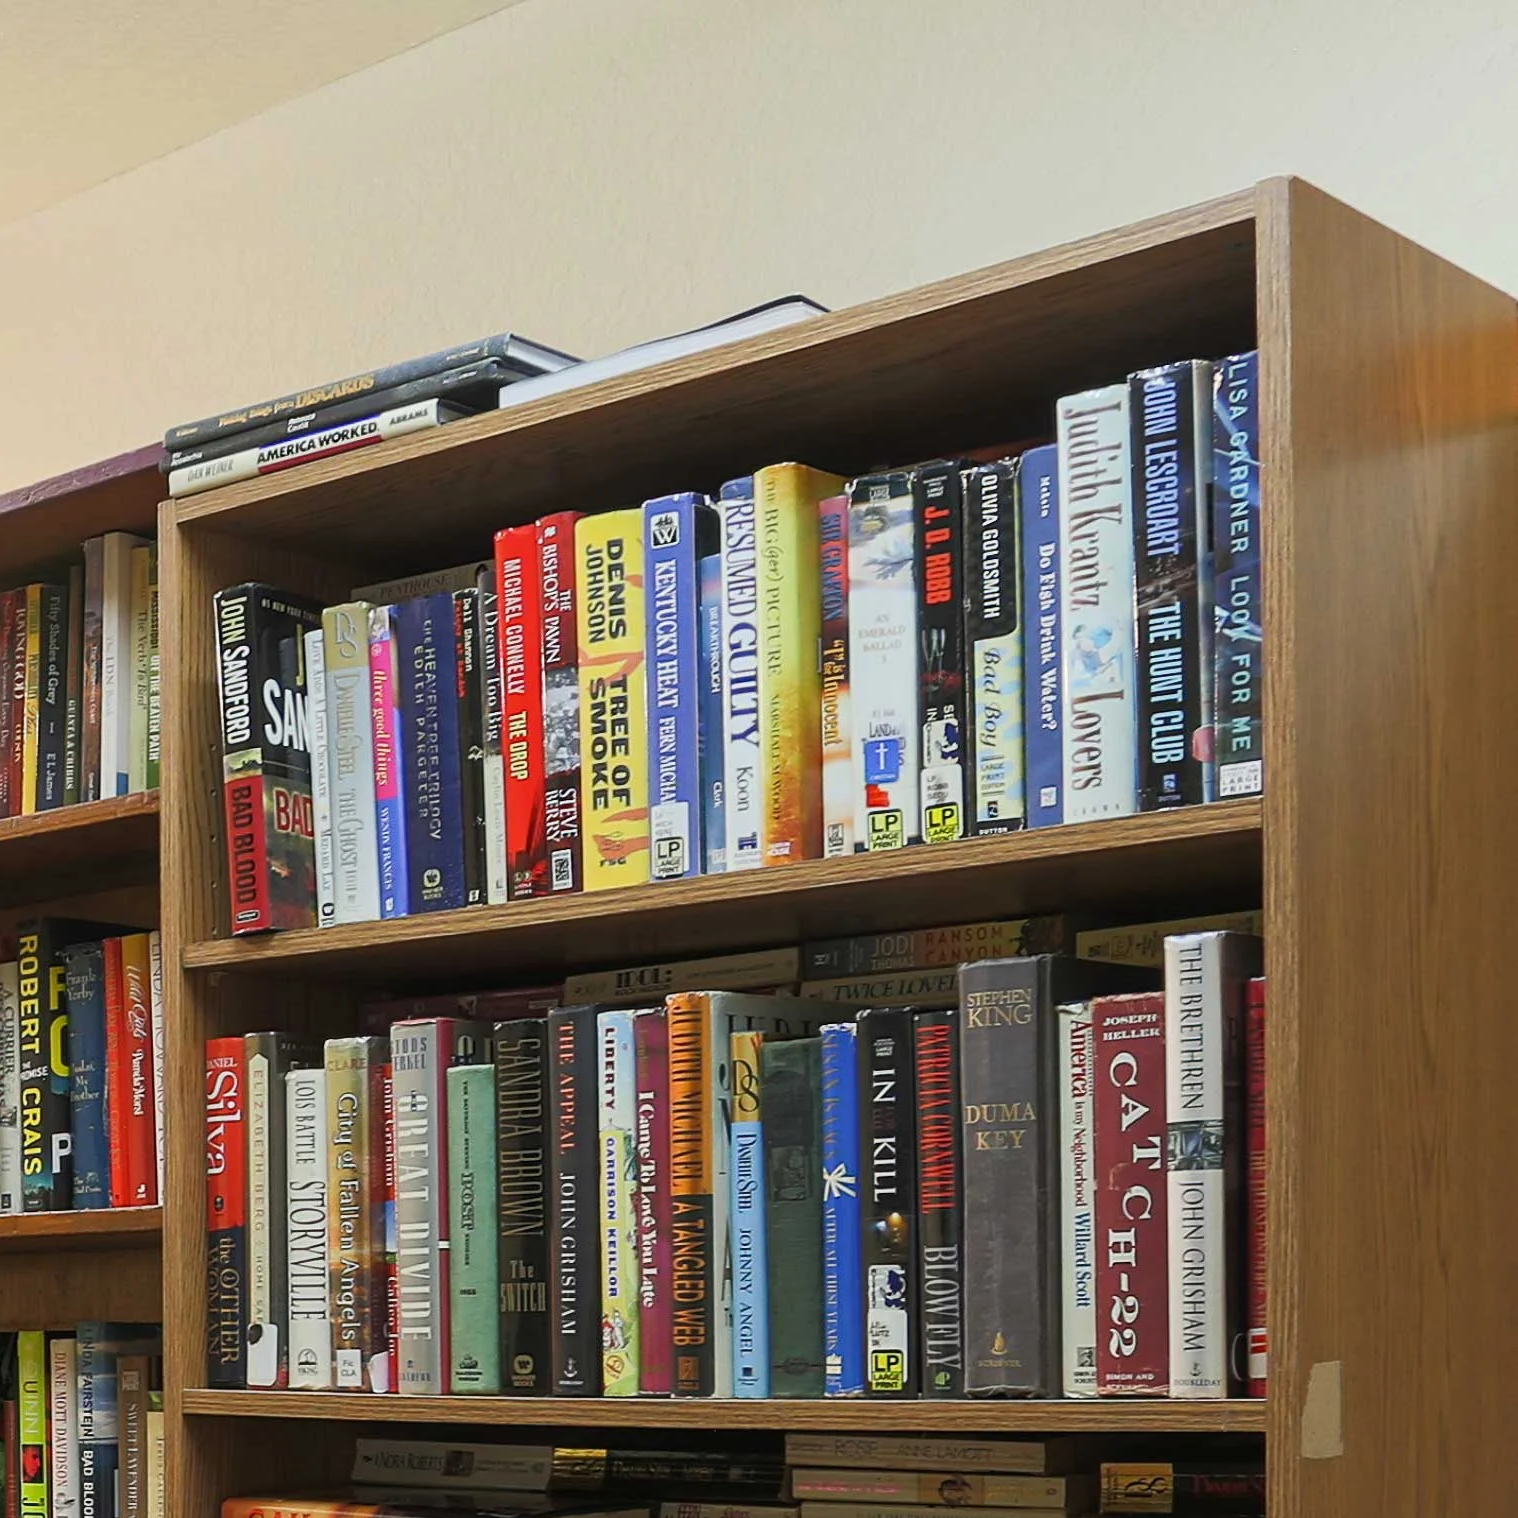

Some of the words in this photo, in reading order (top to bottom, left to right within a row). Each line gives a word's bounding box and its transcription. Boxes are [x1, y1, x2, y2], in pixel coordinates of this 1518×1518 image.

[1143, 380, 1177, 434] JOHN
[1228, 356, 1247, 421] LISA
[389, 408, 428, 426] ABRAMS
[257, 439, 315, 464] AMERICA
[1066, 400, 1123, 491] Judith
[924, 506, 949, 525] J.
[979, 474, 997, 523] OLIVIA
[1144, 440, 1179, 555] LESCROART
[1229, 429, 1250, 553] GARDNER
[924, 529, 950, 548] D.
[1038, 543, 1055, 564] Do
[1068, 502, 1123, 611] Krantz
[503, 558, 522, 625] MICHAEL
[542, 544, 560, 611] BISHOP'S
[560, 589, 572, 612] THE
[586, 544, 606, 644] JOHNSON
[606, 538, 627, 640] DENIS
[924, 552, 953, 605] ROBB
[980, 528, 999, 619] GOLDSMITH
[1038, 568, 1056, 605] Fish
[219, 596, 248, 640] JOHN
[654, 559, 676, 655] KENTUCKY
[1148, 601, 1181, 641] THE
[1230, 576, 1251, 636] LOOK
[505, 629, 526, 695] CONNELLY
[545, 616, 561, 664] PAWN
[1038, 609, 1056, 663] Drink
[224, 644, 250, 744] SANDFORD
[656, 658, 679, 709] HEAT
[728, 621, 760, 749] GUILTY
[982, 651, 1003, 695] Bad
[1039, 665, 1058, 730] Water?
[1148, 645, 1182, 702] HUNT
[1230, 655, 1251, 702] FOR
[508, 710, 527, 741] THE
[608, 673, 628, 756] TREE
[982, 704, 1003, 748] Boy
[1071, 688, 1124, 791] Lovers
[1150, 709, 1185, 764] CLUB
[1231, 712, 1251, 751] ME
[509, 743, 528, 780] DROP
[589, 678, 608, 811] SMOKE
[232, 785, 253, 829] BAD
[561, 788, 578, 837] STEVE
[611, 765, 631, 807] OF
[546, 789, 561, 843] BERRY
[232, 833, 257, 904] BLOOD
[1179, 943, 1203, 982] THE
[20, 935, 40, 1055] ROBERT
[966, 989, 1033, 1007] STEPHEN
[967, 1005, 1033, 1029] KING
[1103, 1013, 1157, 1027] JOSEPH
[559, 1021, 575, 1065] THE
[1103, 1028, 1160, 1040] HELLER
[1179, 987, 1203, 1110] BRETHREN
[499, 1038, 543, 1140] SANDRA
[604, 1026, 616, 1110] LIBERTY
[296, 1079, 315, 1114] LOIS
[333, 1093, 357, 1144] City
[559, 1075, 576, 1158] APPEAL
[965, 1103, 1036, 1125] DUMA
[22, 1086, 42, 1177] CRAIS
[296, 1115, 315, 1165] BATTLE
[976, 1130, 1025, 1150] KEY
[336, 1152, 357, 1169] of
[606, 1137, 616, 1221] GARRISON
[339, 1180, 360, 1251] Fallen
[500, 1149, 544, 1238] BROWN
[559, 1172, 576, 1224] JOHN
[673, 1201, 693, 1215] A
[1107, 1050, 1163, 1359] CATCH-22
[1178, 1181, 1204, 1241] JOHN
[289, 1180, 326, 1321] STORYVILLE
[607, 1225, 618, 1299] KEILLOR
[673, 1220, 706, 1300] TANGLED
[740, 1227, 753, 1293] JOHNNY
[1074, 1212, 1090, 1261] Willard
[509, 1260, 534, 1279] The
[561, 1228, 576, 1335] GRISHAM
[923, 1244, 959, 1324] BLOW
[1074, 1264, 1091, 1308] Scott
[335, 1259, 361, 1341] Angels
[500, 1282, 546, 1313] SWITCH
[1181, 1247, 1204, 1351] GRISHAM
[674, 1305, 705, 1347] WEB
[740, 1302, 754, 1358] ANGEL
[925, 1328, 962, 1371] FLY
[82, 1450, 93, 1477] BAD
